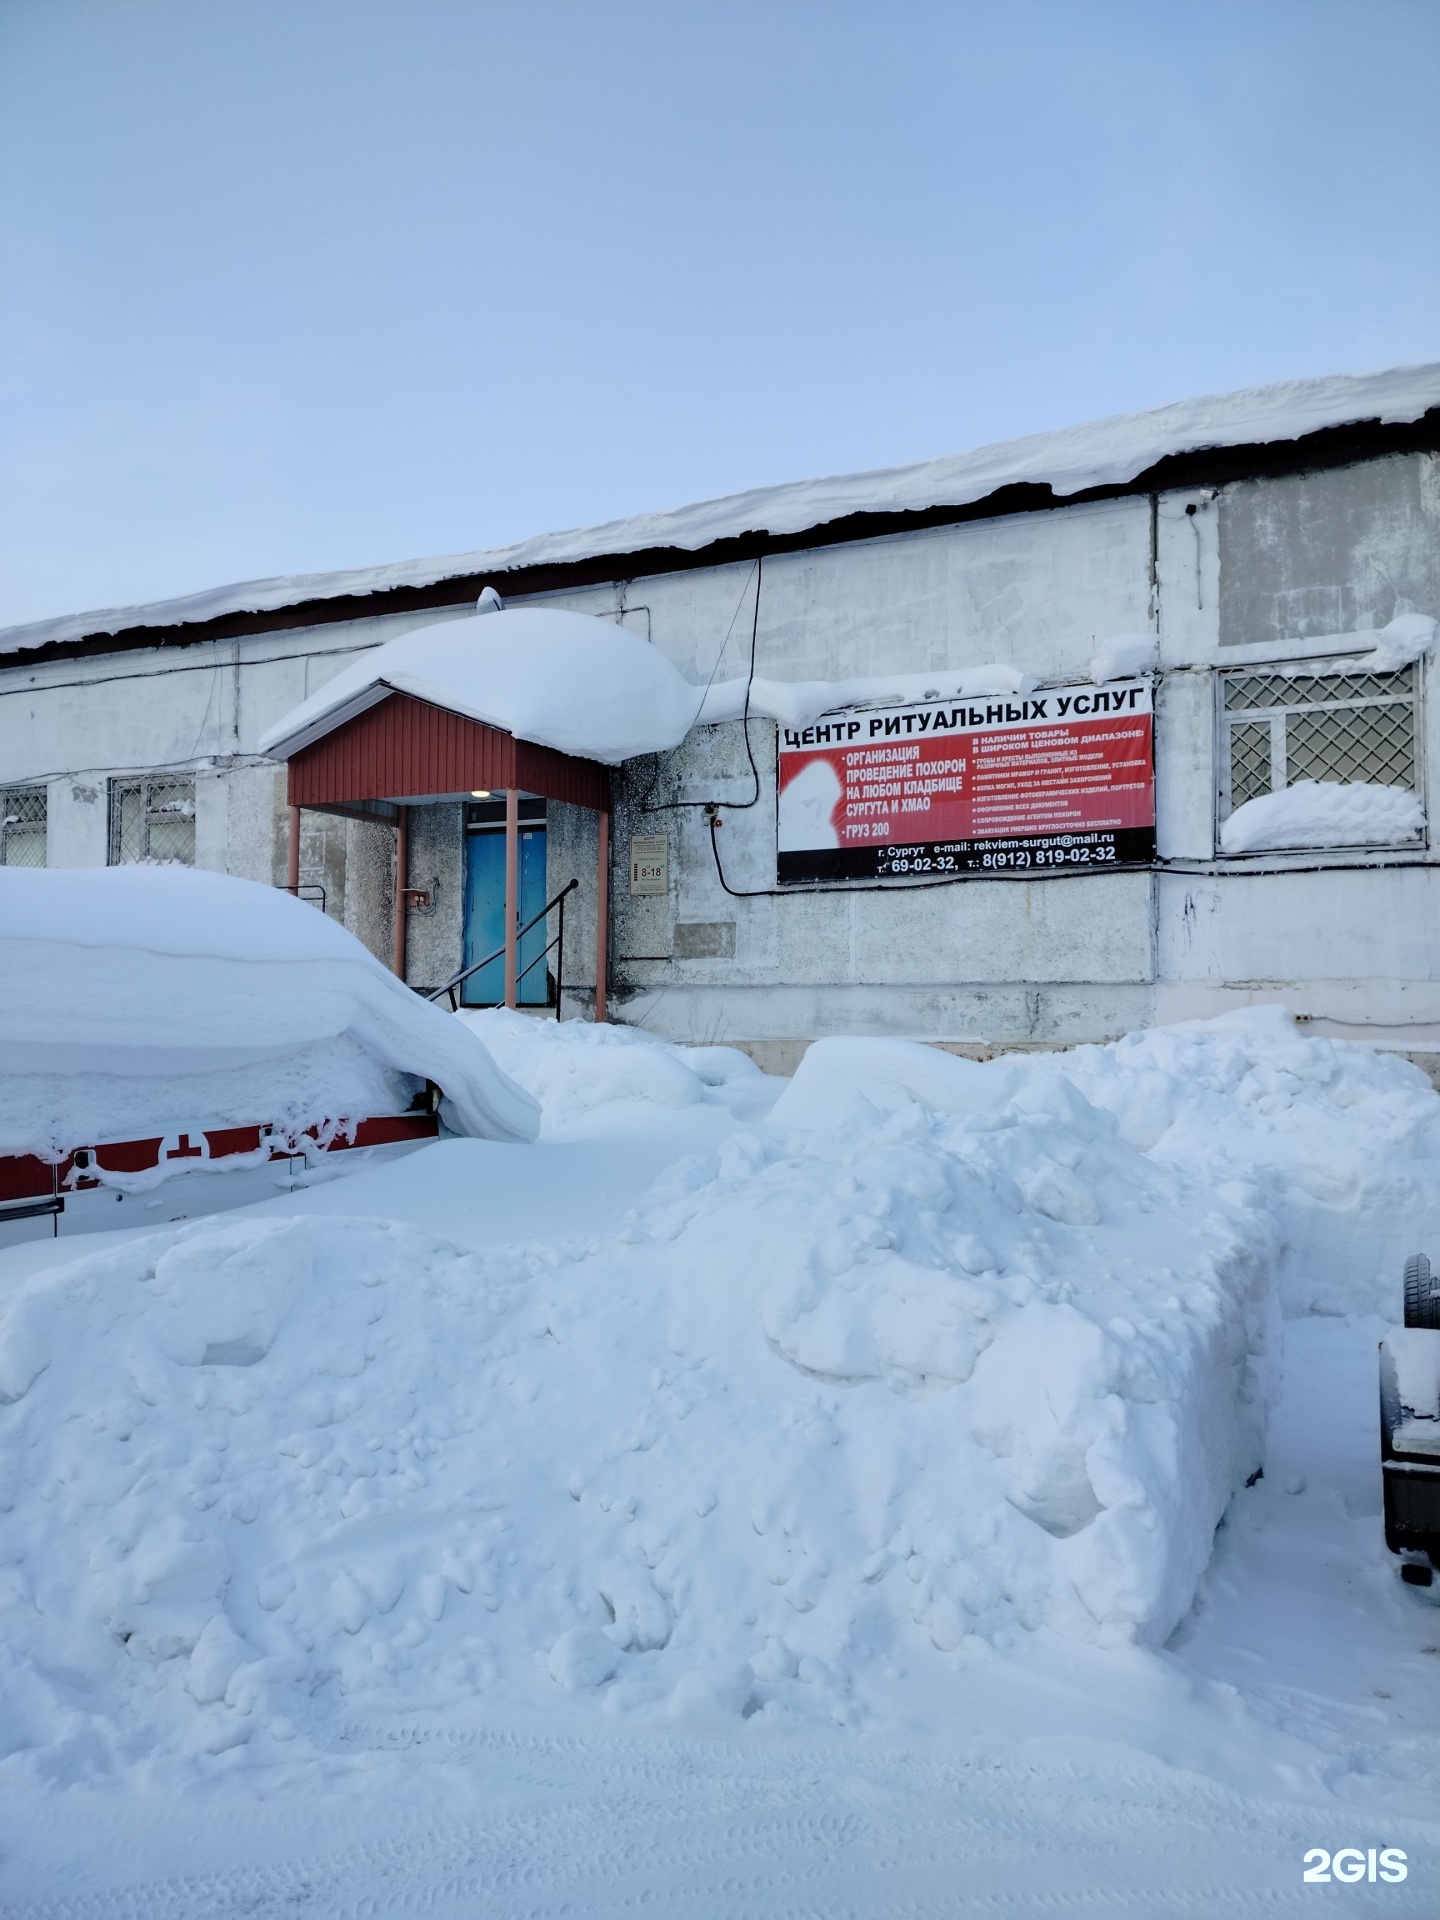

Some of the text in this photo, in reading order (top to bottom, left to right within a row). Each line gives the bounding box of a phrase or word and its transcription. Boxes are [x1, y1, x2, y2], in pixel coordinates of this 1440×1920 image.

[785, 688, 1144, 749] ЦЕНТР РИТУАЛЬНЫХ УСЛУГ
[981, 733, 1027, 745] НАЛИЧИИ
[1029, 729, 1069, 740] ТОВАРЫ
[981, 742, 1029, 753] ШИРОКОМ
[1031, 737, 1078, 749] ЦЕНОВОМ
[1081, 730, 1144, 744] ДИАПАЗОНЕ:
[846, 745, 919, 766] ОРГАНИЗАЦИЯ
[1001, 754, 1024, 762] КРЕСТЫ
[1079, 752, 1104, 760] МОДЕЛИ
[846, 759, 966, 783] ПРОВЕДЕНИЕ ПОХОРОН
[976, 772, 1010, 781] ПАМЯТНИКИ
[1011, 769, 1034, 778] МРАМОР
[1064, 763, 1111, 774] ИЗГОТОВЛЕНИЕ,
[1112, 759, 1146, 769] УСТАНОВКА
[846, 776, 963, 800] НА ЛЮБОМ КЛАДБИЩЕ
[1017, 780, 1032, 788] УХОД
[1041, 778, 1069, 786] МЕСТАМИ
[1069, 773, 1112, 784] ЗАХОРОНЕНИЙ
[976, 793, 1019, 802] ИЗГОТОВЛЕНИЕ
[1019, 787, 1080, 799] ФОТОКЕРАМИЧЕСКИХ
[1110, 782, 1145, 791] ПОРТРЕТОВ
[846, 797, 931, 817] СУРГУТА И ХМАО
[976, 804, 1014, 813] ОФОРМЛЕНИЕ
[1030, 800, 1068, 810] ДОКУМЕНТОВ
[976, 810, 1081, 824] СОПРОВОЖДЕНИЕ АГЕНТОМ ПОХОРОН
[976, 818, 1122, 835] ЭВАКУАЦИЯ УМЕРШИХ КРУГЛОСУТОЧНО БЕСПЛАТНО
[846, 822, 889, 839] ГРУЗ 200
[878, 833, 1115, 858] г. Сургут e-mail: rekviem-surgut@mail.ru
[891, 856, 959, 873] 69-02-32,
[967, 859, 979, 868] т.:
[982, 851, 1031, 869] 8(912)
[1035, 846, 1116, 864] 819-02-32
